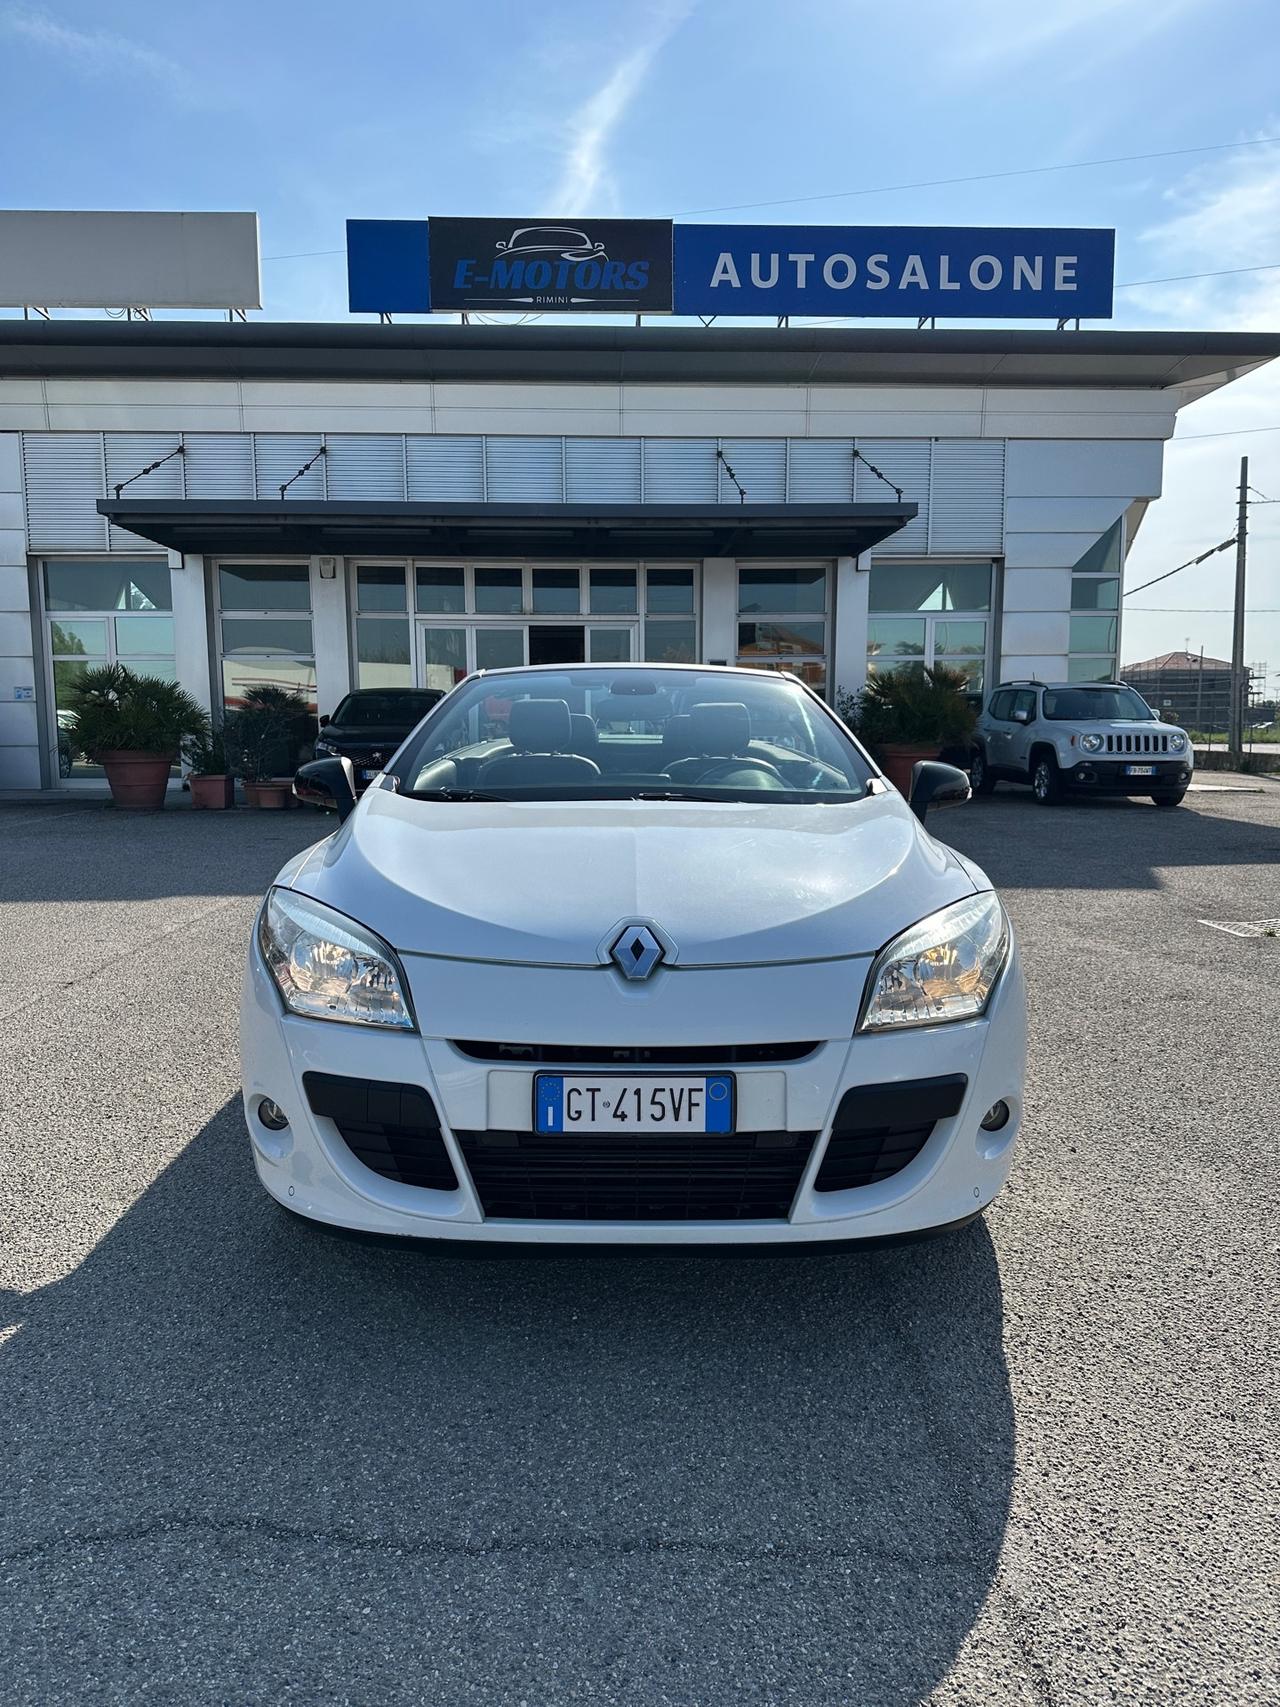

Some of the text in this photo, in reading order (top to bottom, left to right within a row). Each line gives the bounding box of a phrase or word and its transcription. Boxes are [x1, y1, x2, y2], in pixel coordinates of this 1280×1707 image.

[453, 259, 650, 290] E-MOTORS
[710, 252, 1078, 291] AUTOSALONE
[536, 295, 568, 304] RIMINI
[566, 1087, 601, 1122] GT
[612, 1087, 704, 1122] 415VF
